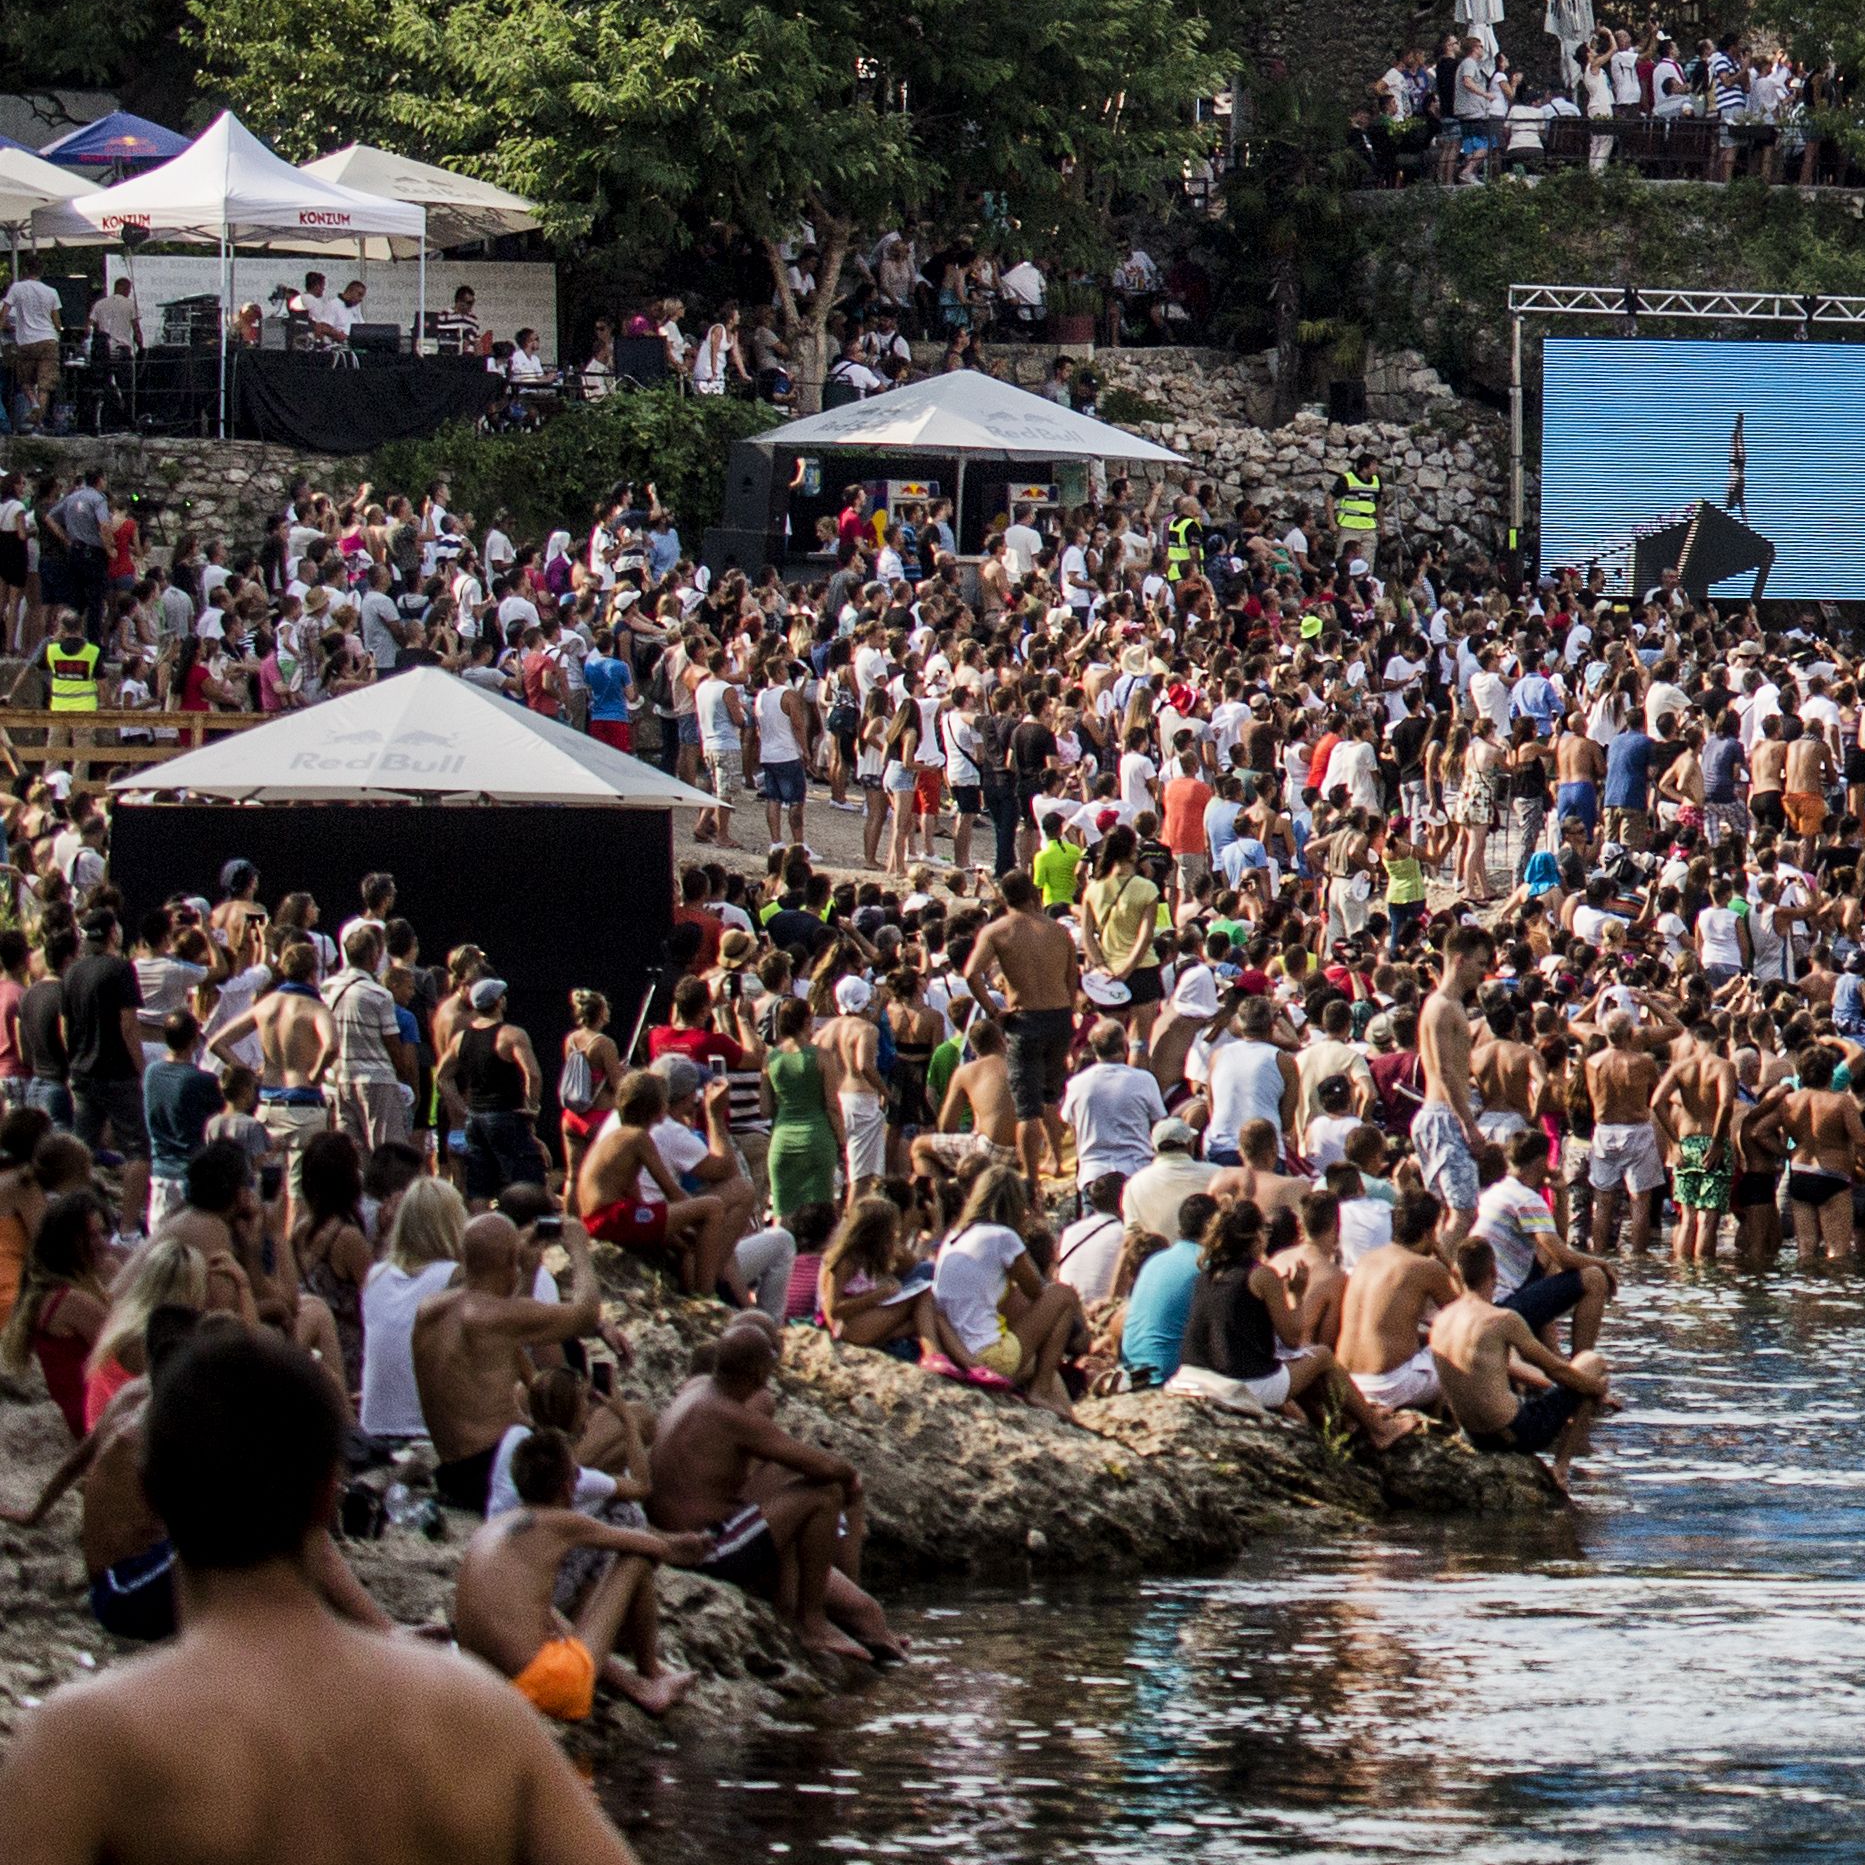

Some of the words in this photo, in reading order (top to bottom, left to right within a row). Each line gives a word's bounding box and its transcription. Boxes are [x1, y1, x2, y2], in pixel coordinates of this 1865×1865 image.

[102, 214, 151, 230] KONZUM
[299, 210, 351, 226] KONZUM
[289, 751, 378, 771] Red
[379, 752, 466, 774] Bull
